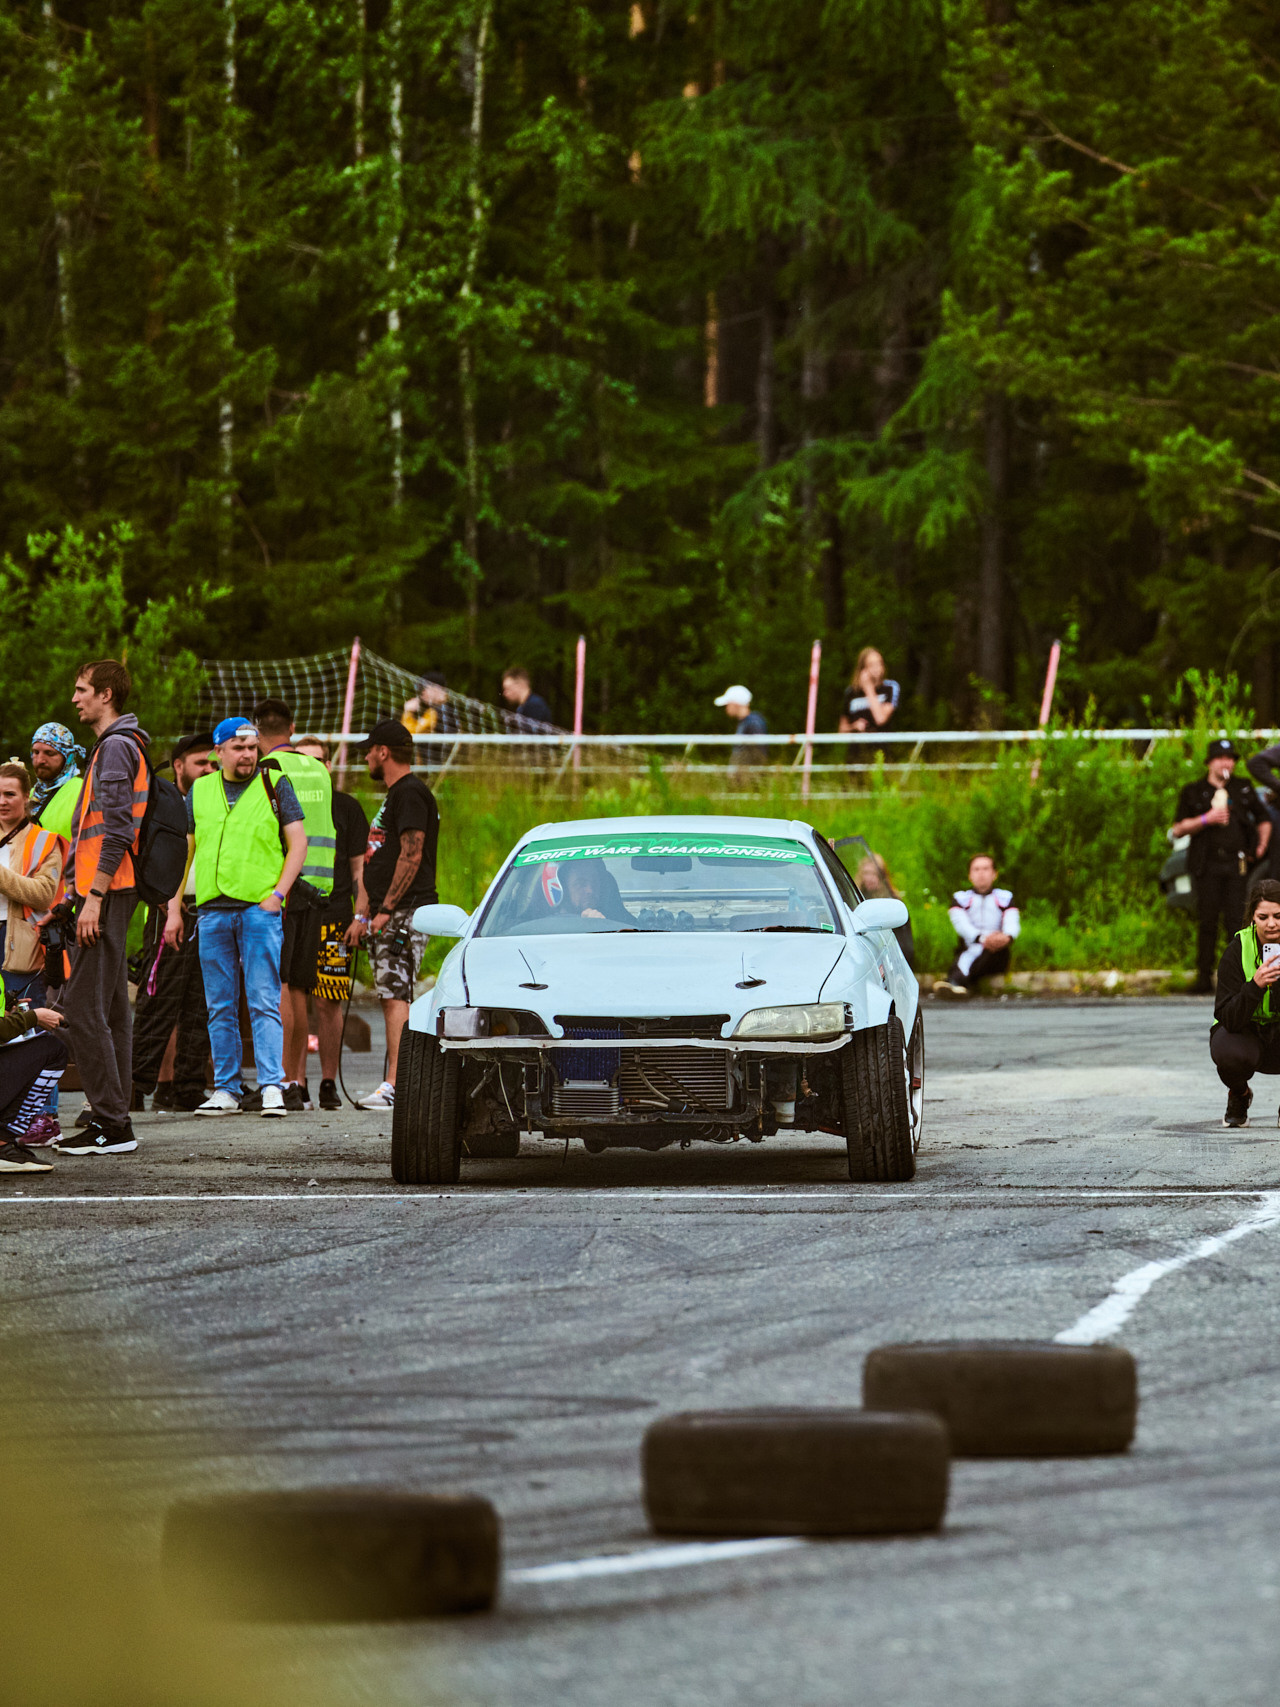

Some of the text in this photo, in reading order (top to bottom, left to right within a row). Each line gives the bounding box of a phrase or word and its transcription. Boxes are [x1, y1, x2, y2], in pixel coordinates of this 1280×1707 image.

[522, 846, 798, 863] DRIFT WARS CHAMPIONSHIP
